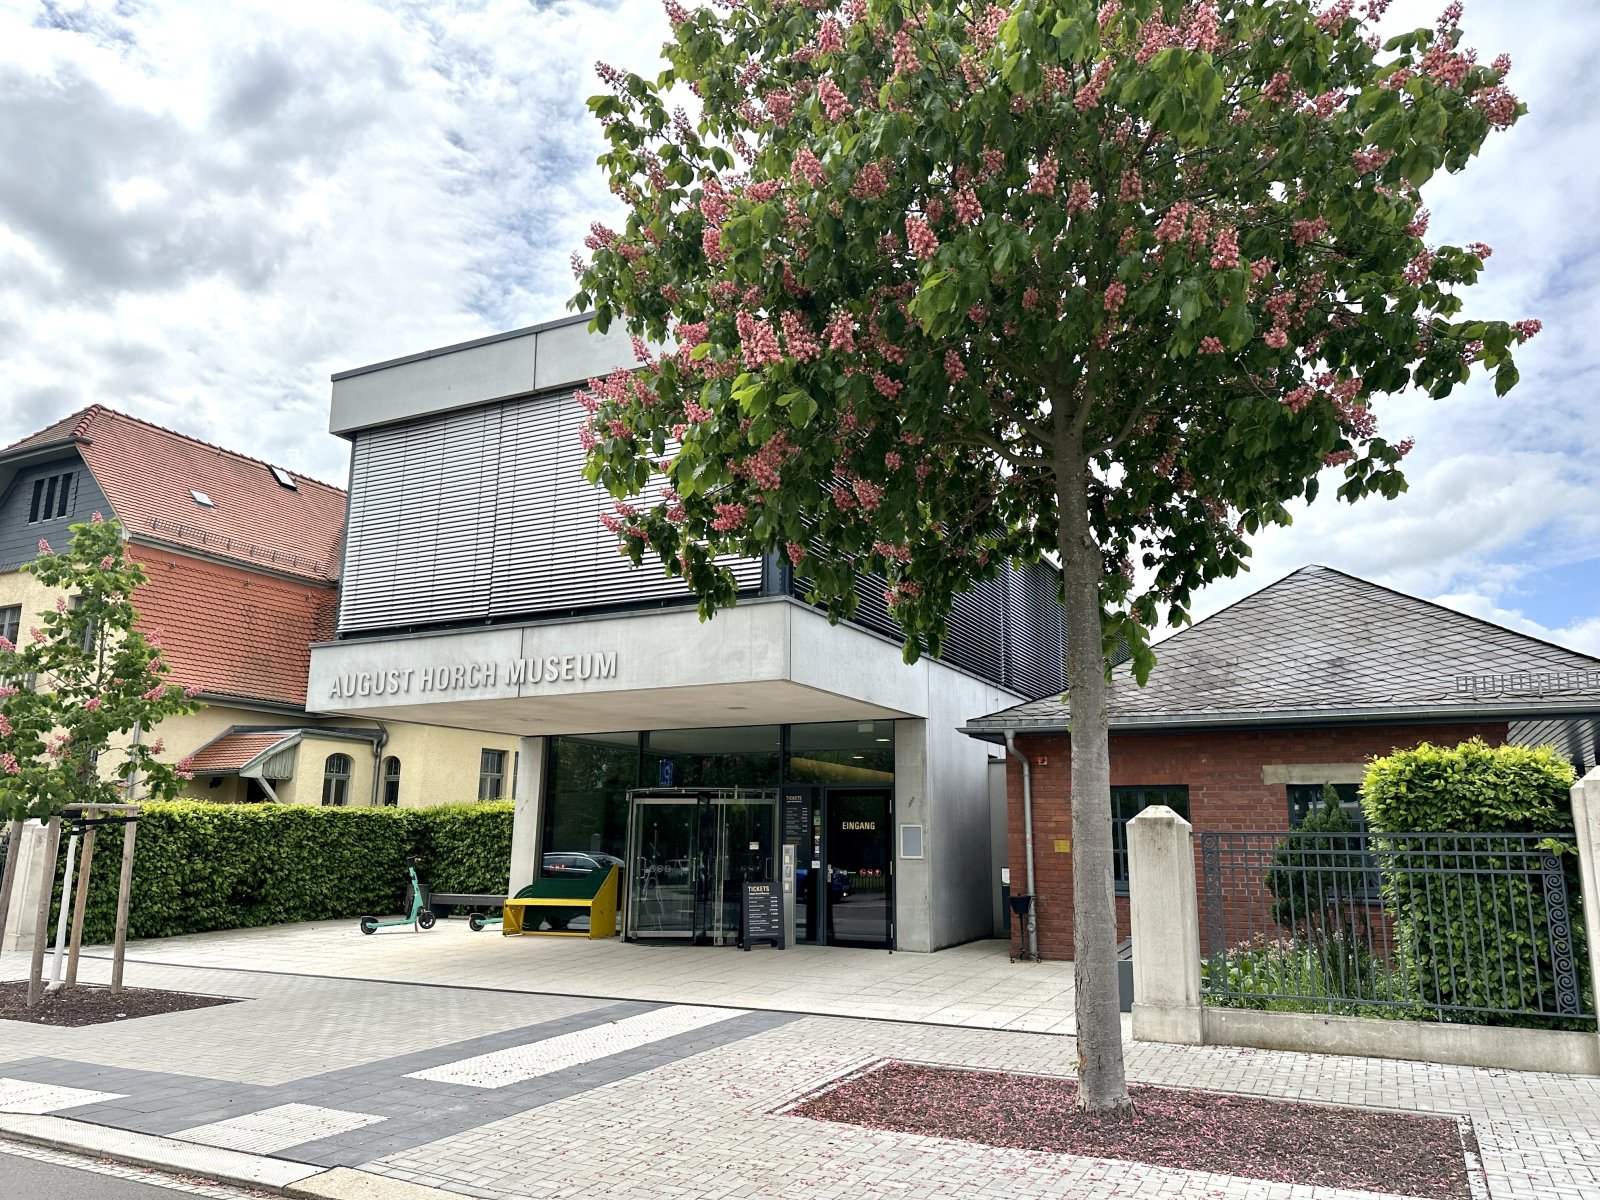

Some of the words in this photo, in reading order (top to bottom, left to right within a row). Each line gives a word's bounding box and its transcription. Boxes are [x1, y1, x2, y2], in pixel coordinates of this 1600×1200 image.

[328, 667, 415, 699] AUGUST
[420, 660, 497, 693] HORCH
[504, 651, 618, 687] MUSEUM
[842, 821, 875, 830] EINGANG
